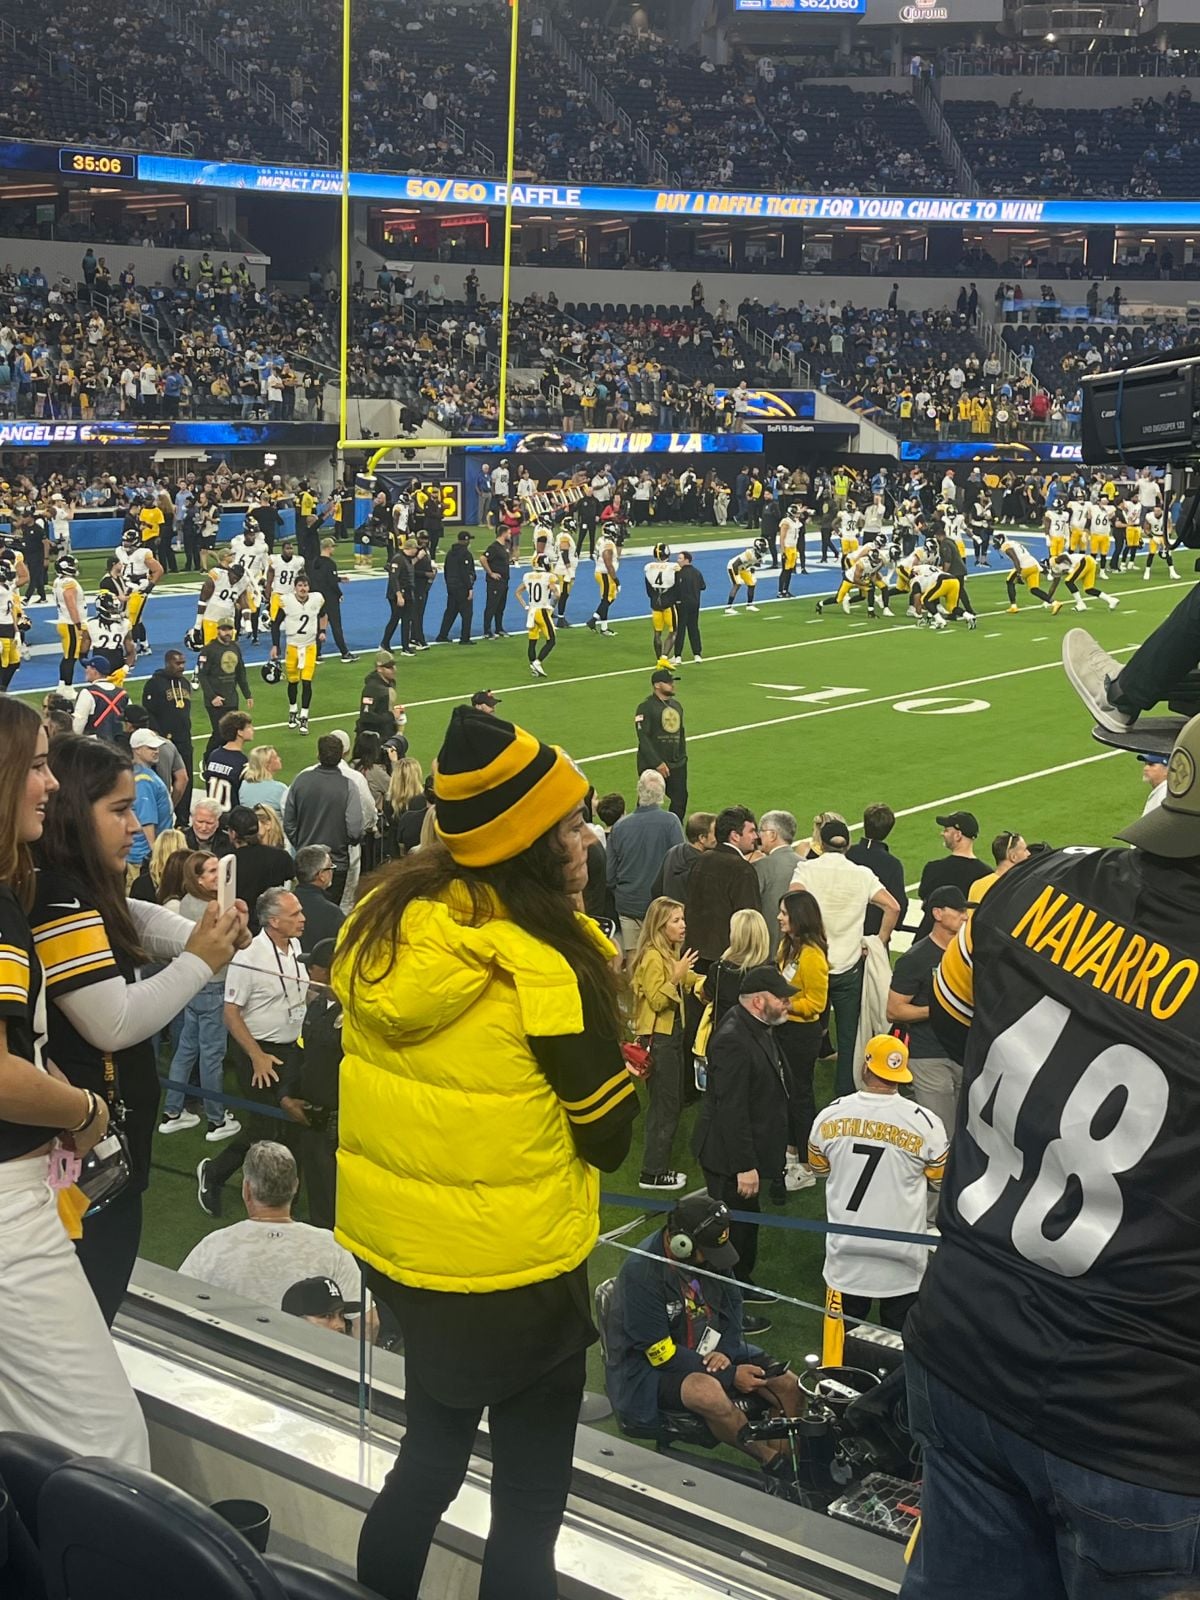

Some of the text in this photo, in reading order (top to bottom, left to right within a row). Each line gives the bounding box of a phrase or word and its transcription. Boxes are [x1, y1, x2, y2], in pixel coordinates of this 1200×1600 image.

[899, 6, 948, 23] Corona
[73, 155, 121, 173] 35:06
[256, 175, 310, 190] IMPACT
[406, 179, 582, 206] 50/50 RAFFLE
[655, 192, 1044, 220] BUY A RAFFLE TICKET FOR YOUR CHANCE TO WIN!
[0, 425, 77, 441] ANGELES
[586, 433, 702, 453] BOLT UP LA
[1050, 445, 1082, 458] LOS
[1055, 520, 1064, 531] 57
[1095, 516, 1108, 526] 66
[239, 554, 256, 569] 67
[280, 570, 294, 585] 81
[655, 572, 663, 585] 4
[528, 582, 542, 603] 10
[297, 615, 309, 634] 2
[207, 776, 232, 812] 10
[1011, 884, 1200, 1020] NAVARRO
[914, 1107, 934, 1129] 7
[820, 1117, 924, 1157] ROETHLISBERGER
[957, 995, 1170, 1278] 48
[845, 1143, 886, 1212] 7
[324, 1280, 340, 1296] LA
